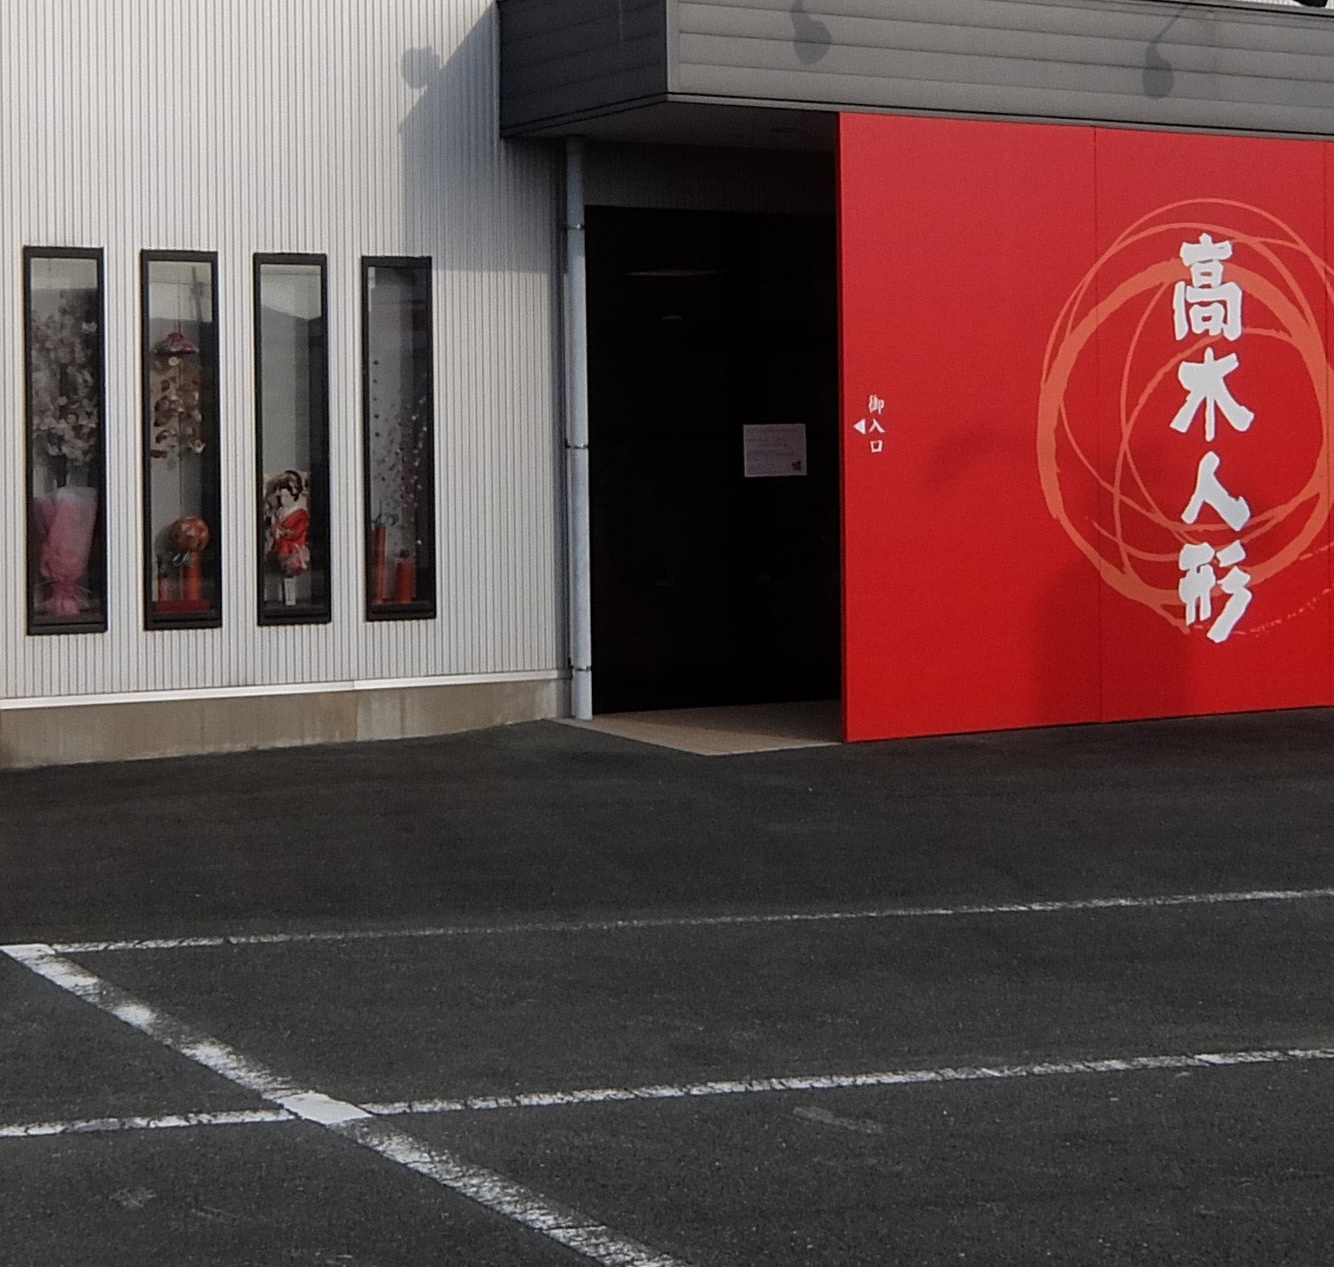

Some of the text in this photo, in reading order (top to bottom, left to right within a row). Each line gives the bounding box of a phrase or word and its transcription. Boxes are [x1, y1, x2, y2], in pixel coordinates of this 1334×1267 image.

[868, 394, 885, 453] 御入口
[1170, 233, 1254, 644] 高木人形
